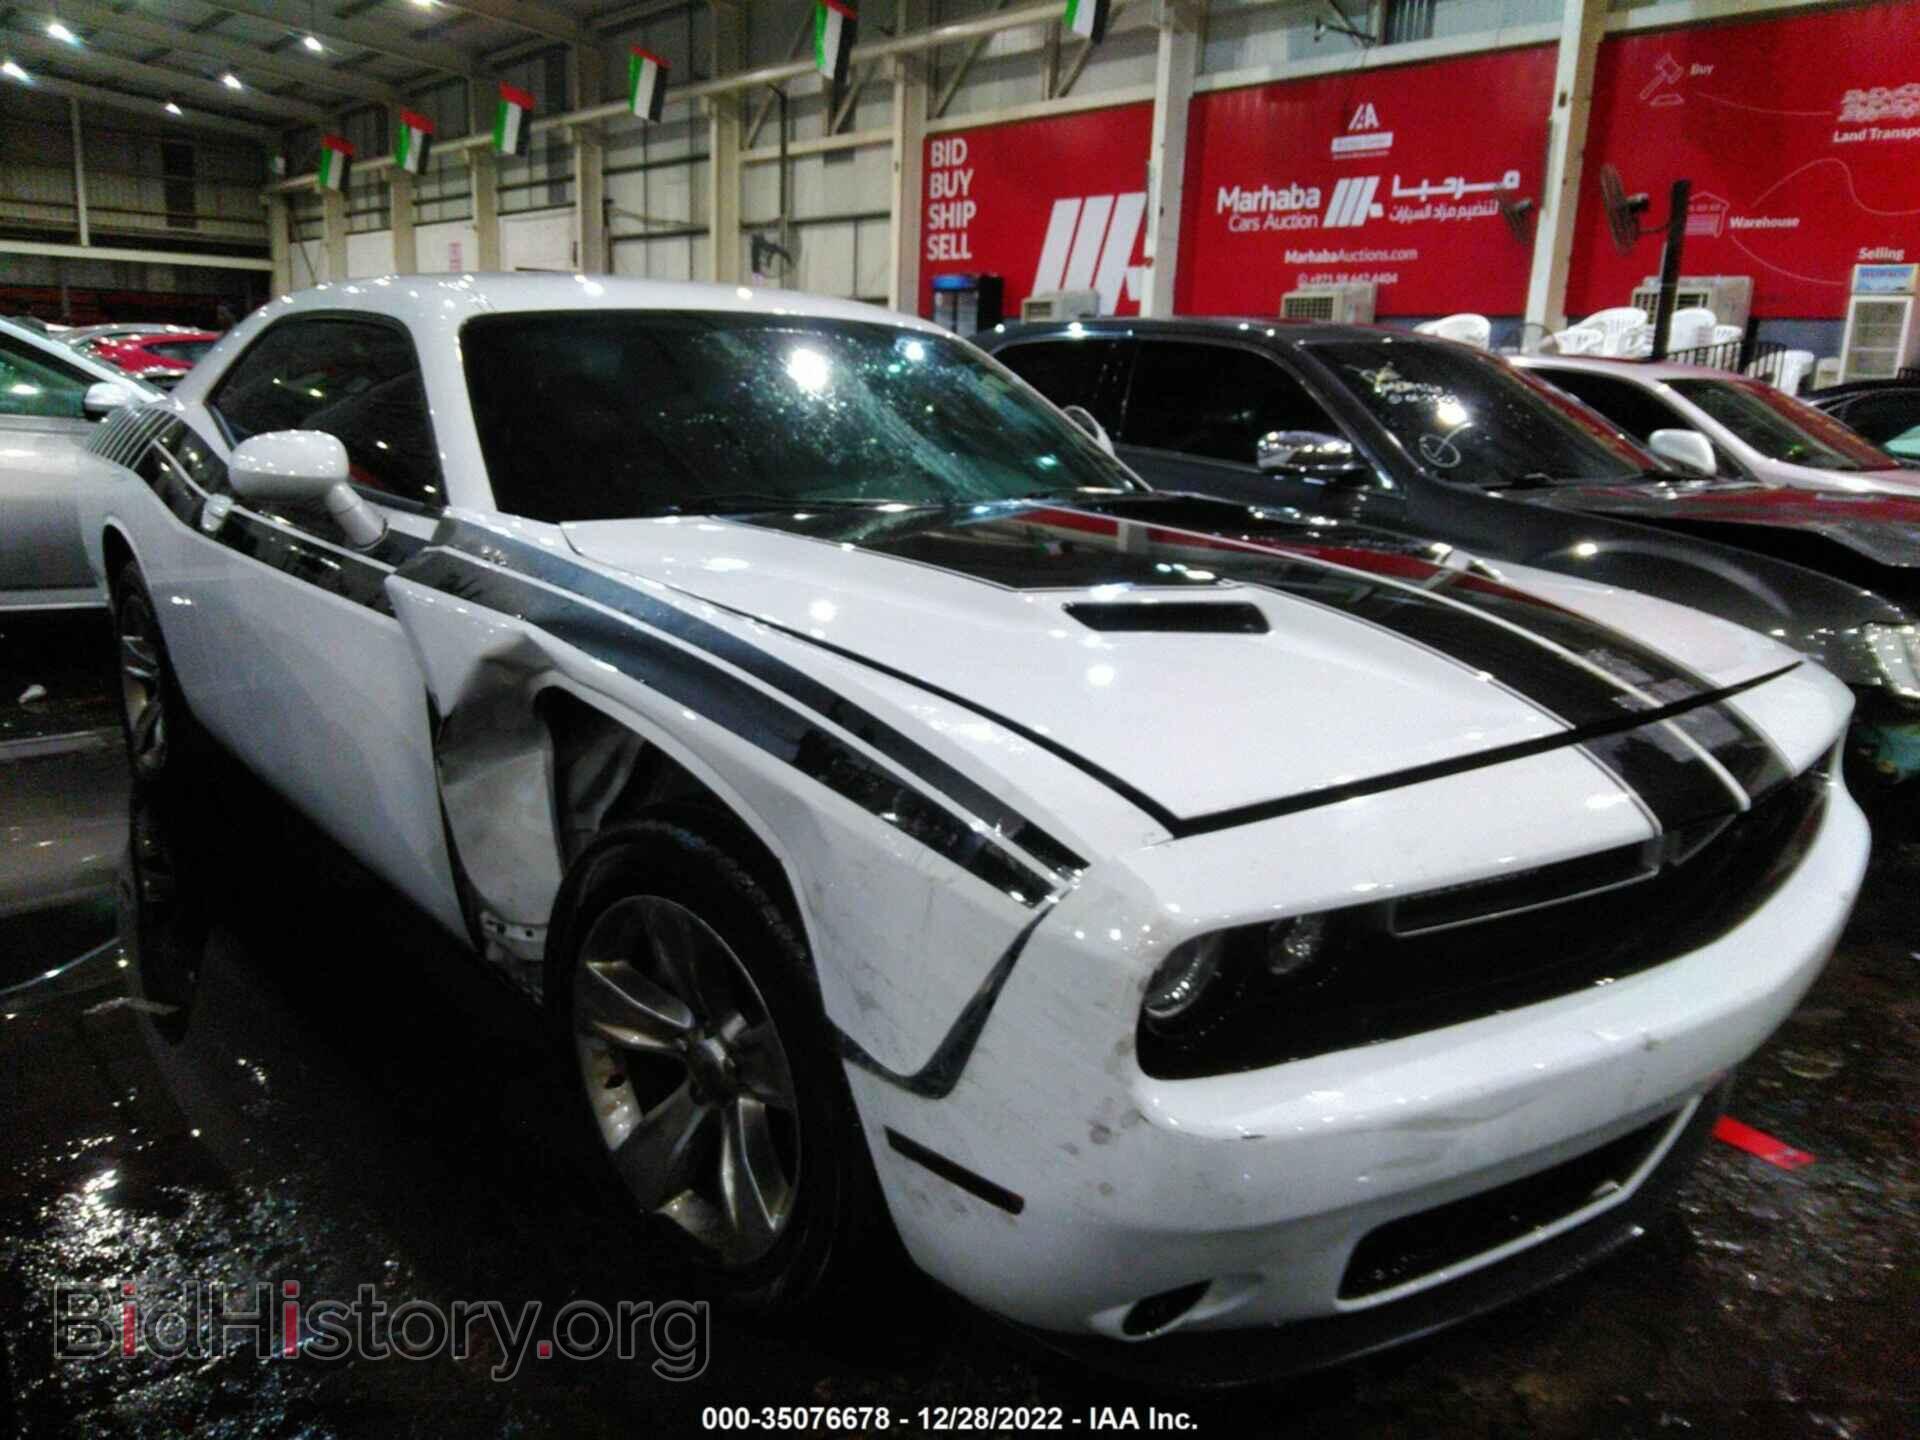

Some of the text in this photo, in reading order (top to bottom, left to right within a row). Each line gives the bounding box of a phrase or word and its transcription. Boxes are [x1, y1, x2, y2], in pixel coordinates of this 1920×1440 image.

[1833, 129, 1867, 142] Land
[931, 138, 967, 167] BID
[929, 169, 974, 199] BUY
[1218, 183, 1321, 213] Marhaba
[928, 200, 976, 229] SHIP
[1228, 211, 1319, 232] Cars Auction
[1730, 216, 1799, 229] Warehouse
[927, 233, 972, 260] SELL
[1858, 247, 1904, 261] Selling
